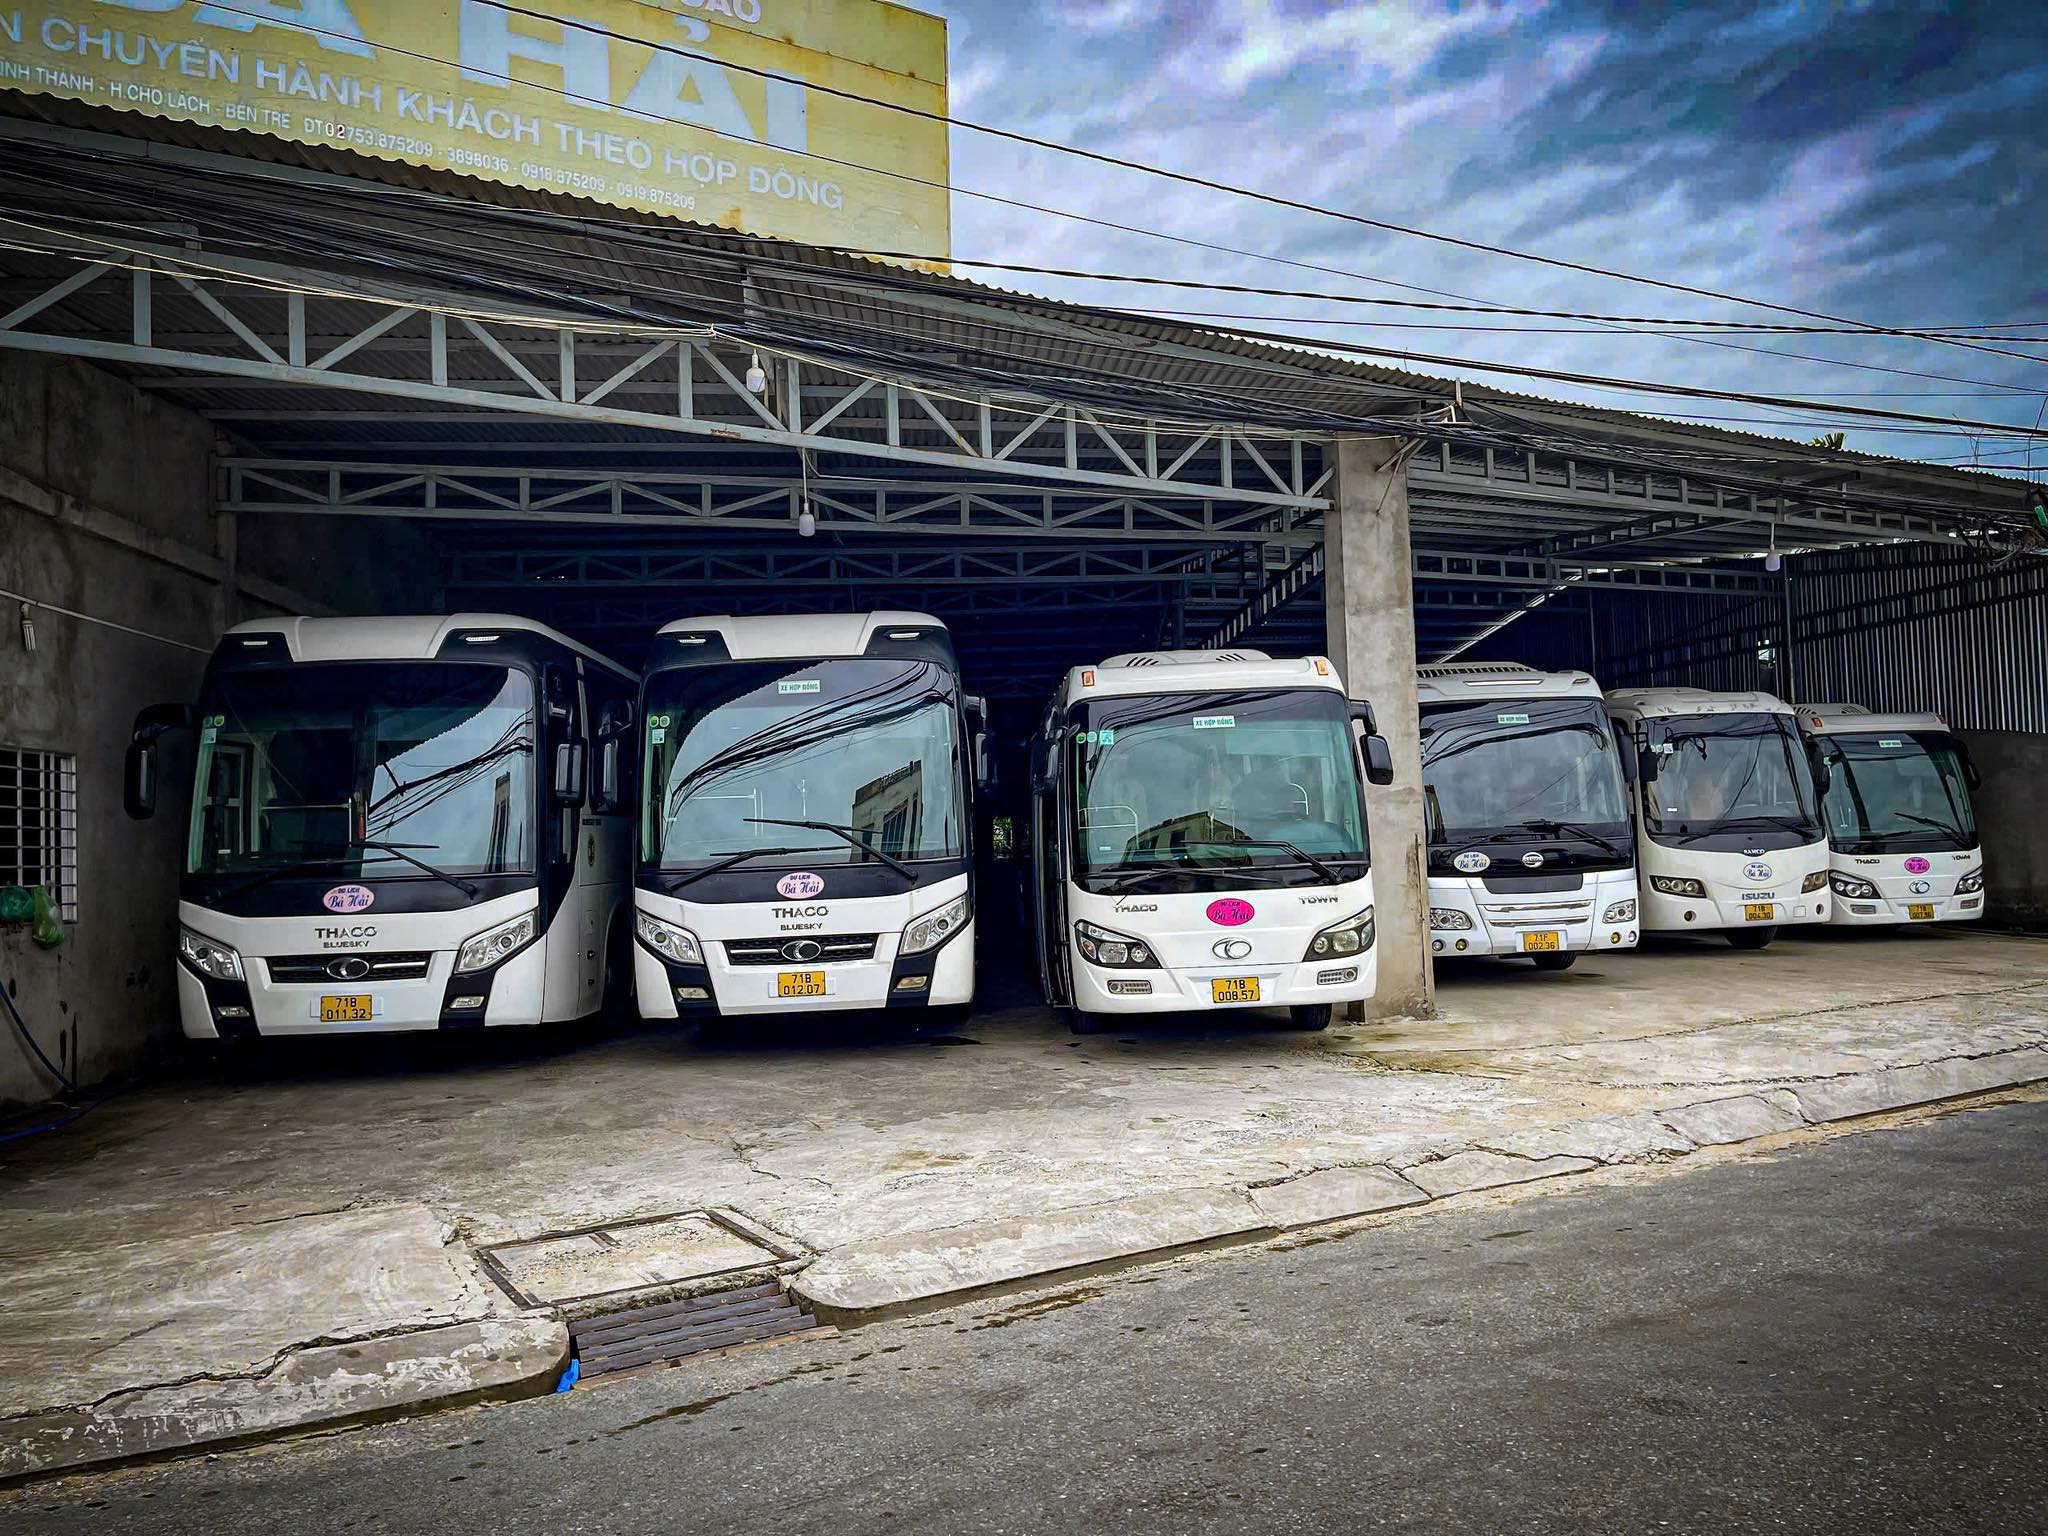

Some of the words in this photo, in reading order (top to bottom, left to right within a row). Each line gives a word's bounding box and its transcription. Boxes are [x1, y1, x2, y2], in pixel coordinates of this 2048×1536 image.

[680, 0, 762, 24] AO
[256, 56, 382, 113] HÀNH
[397, 86, 541, 146] KHÁCH
[552, 121, 653, 170] THEO
[260, 109, 291, 129] TRE
[447, 146, 509, 173] 3898036
[1299, 895, 1339, 905] TOWN
[772, 906, 829, 918] THACO
[1113, 904, 1158, 913] THACO
[315, 926, 377, 938] THACO
[791, 973, 812, 984] 71B
[1225, 979, 1246, 990] 71B
[783, 984, 820, 995] 012.07
[1218, 989, 1255, 1001] 008.57
[335, 997, 357, 1008] 71B
[326, 1008, 366, 1020] 011.32
